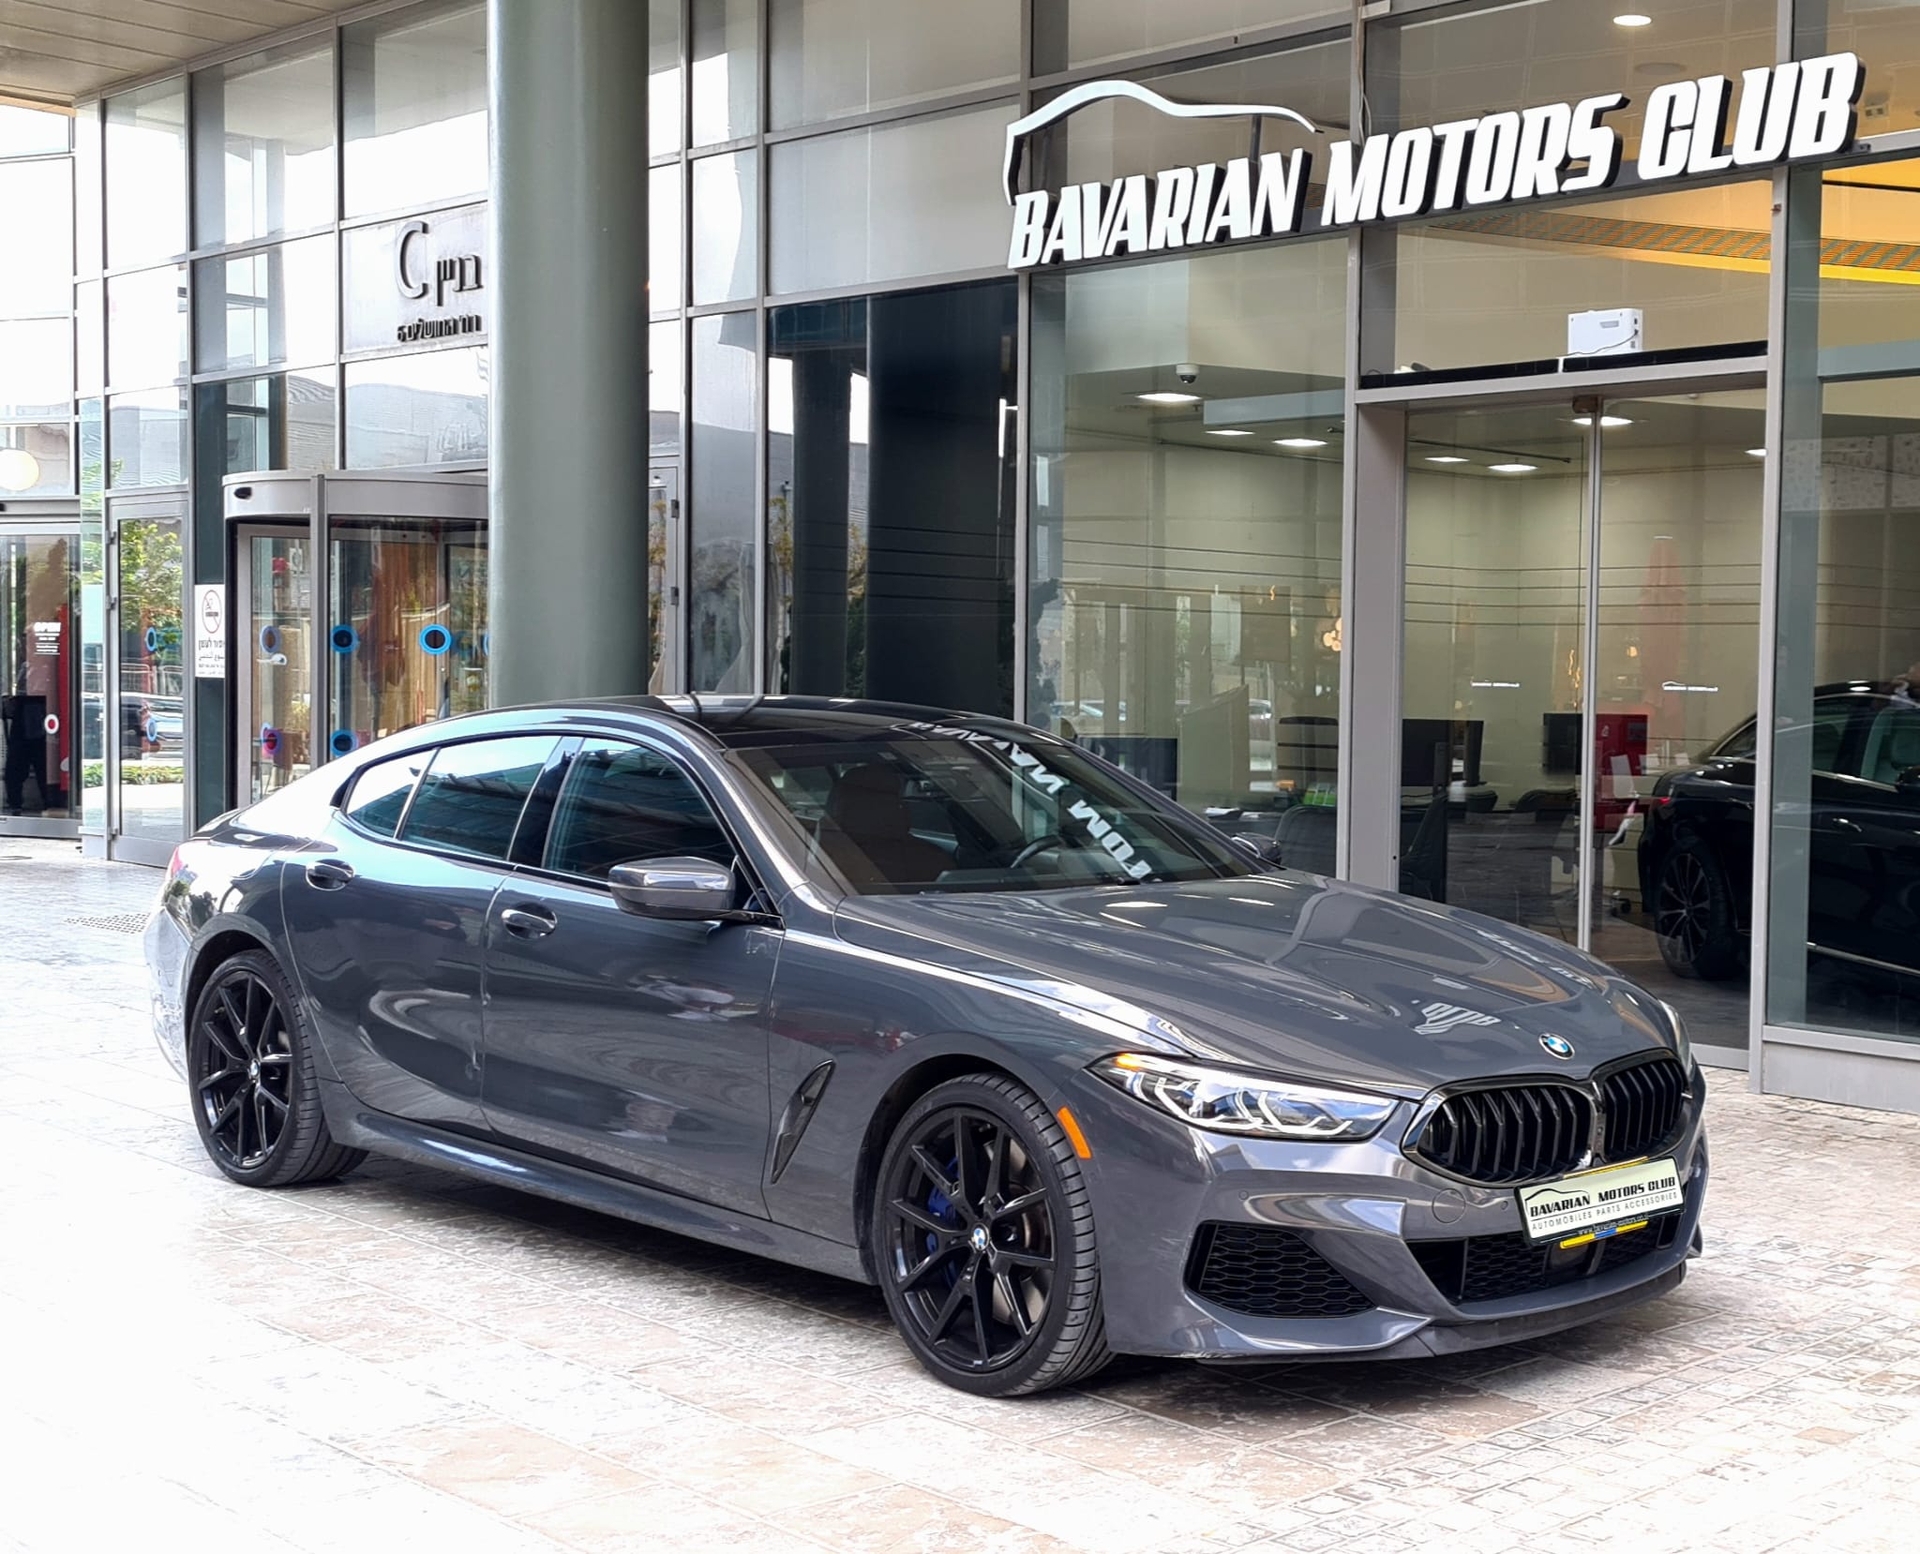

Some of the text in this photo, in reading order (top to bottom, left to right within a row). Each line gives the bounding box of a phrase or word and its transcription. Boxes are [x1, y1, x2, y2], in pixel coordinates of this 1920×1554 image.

[1007, 51, 1863, 270] BAVARIAN MOTORS CLUB
[396, 219, 430, 300] C
[1529, 1176, 1676, 1218] BAVARIAN MOTORS CLUB
[1531, 1191, 1678, 1231] AUTOMOBILES PARTS ACCESSORIES
